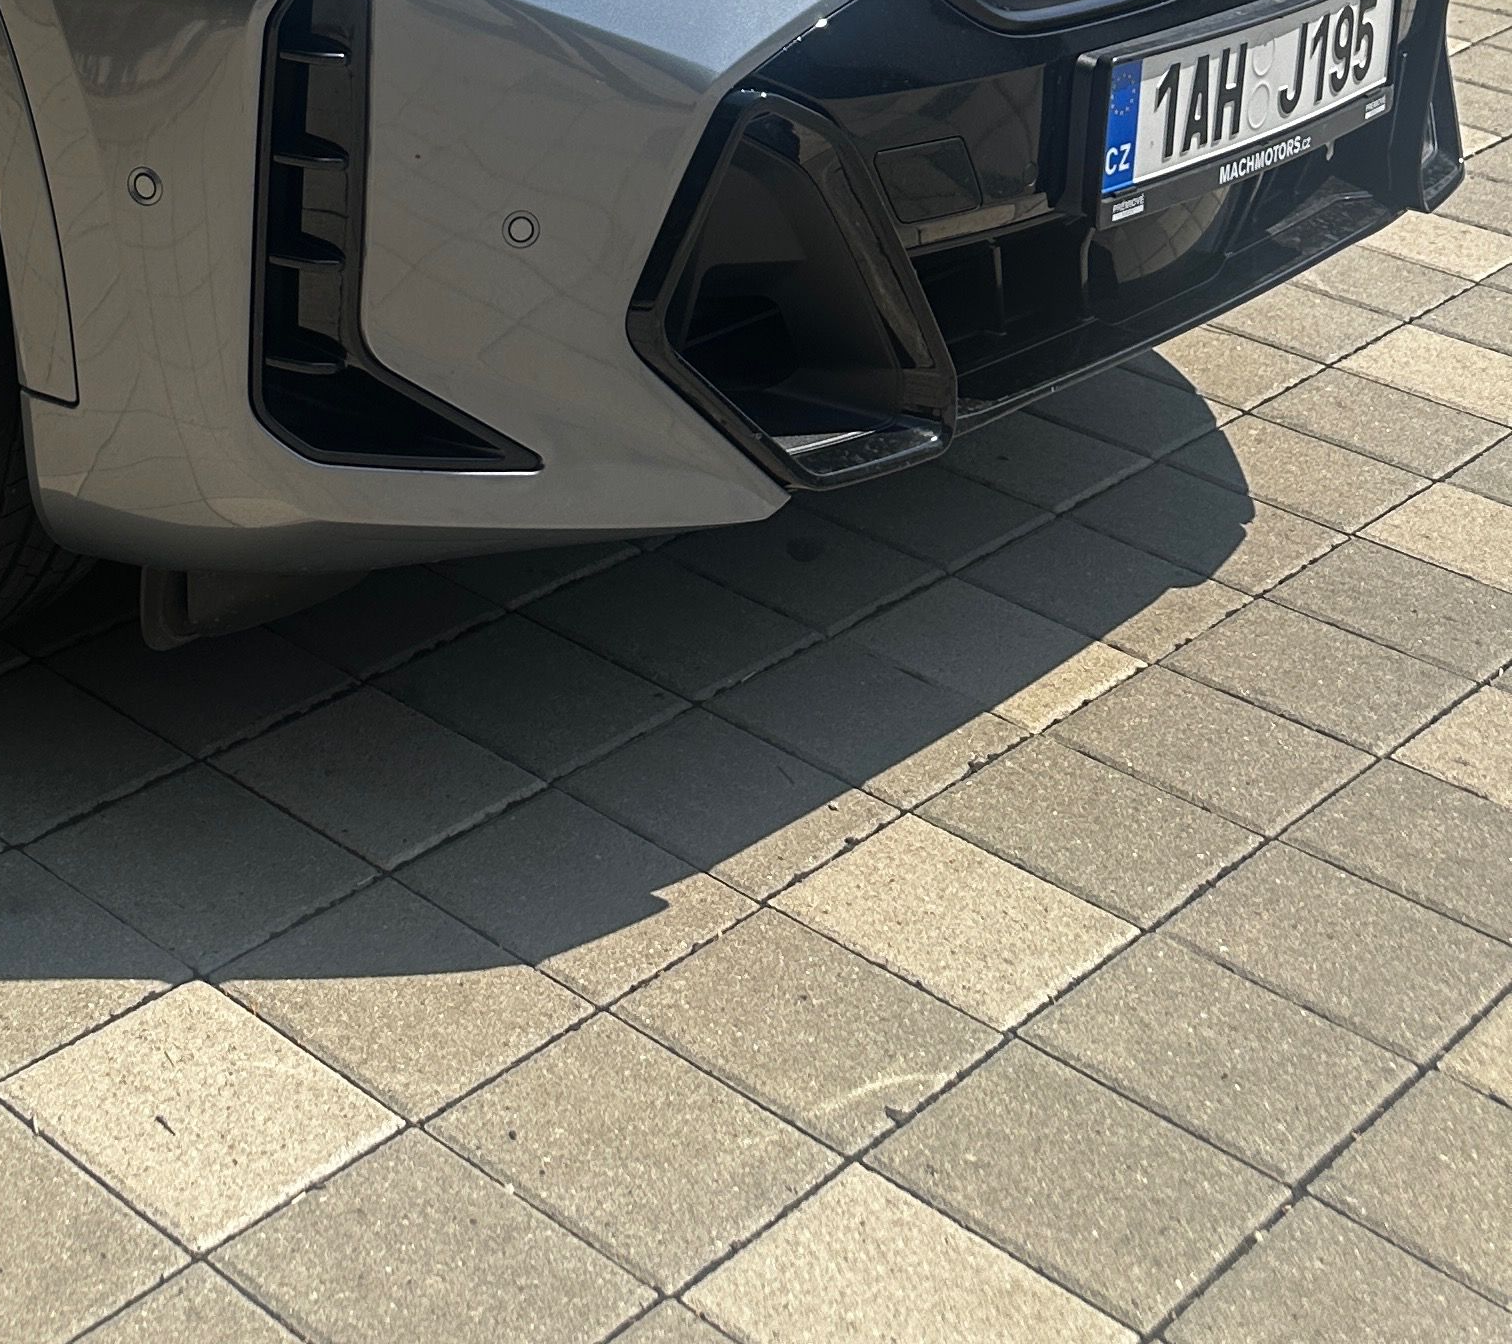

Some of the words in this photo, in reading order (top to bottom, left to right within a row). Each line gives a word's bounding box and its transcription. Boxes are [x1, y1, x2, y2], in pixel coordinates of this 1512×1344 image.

[1154, 42, 1248, 162] 1AH
[1105, 143, 1132, 175] CZ
[1219, 136, 1312, 184] MACHMOTORS.cz
